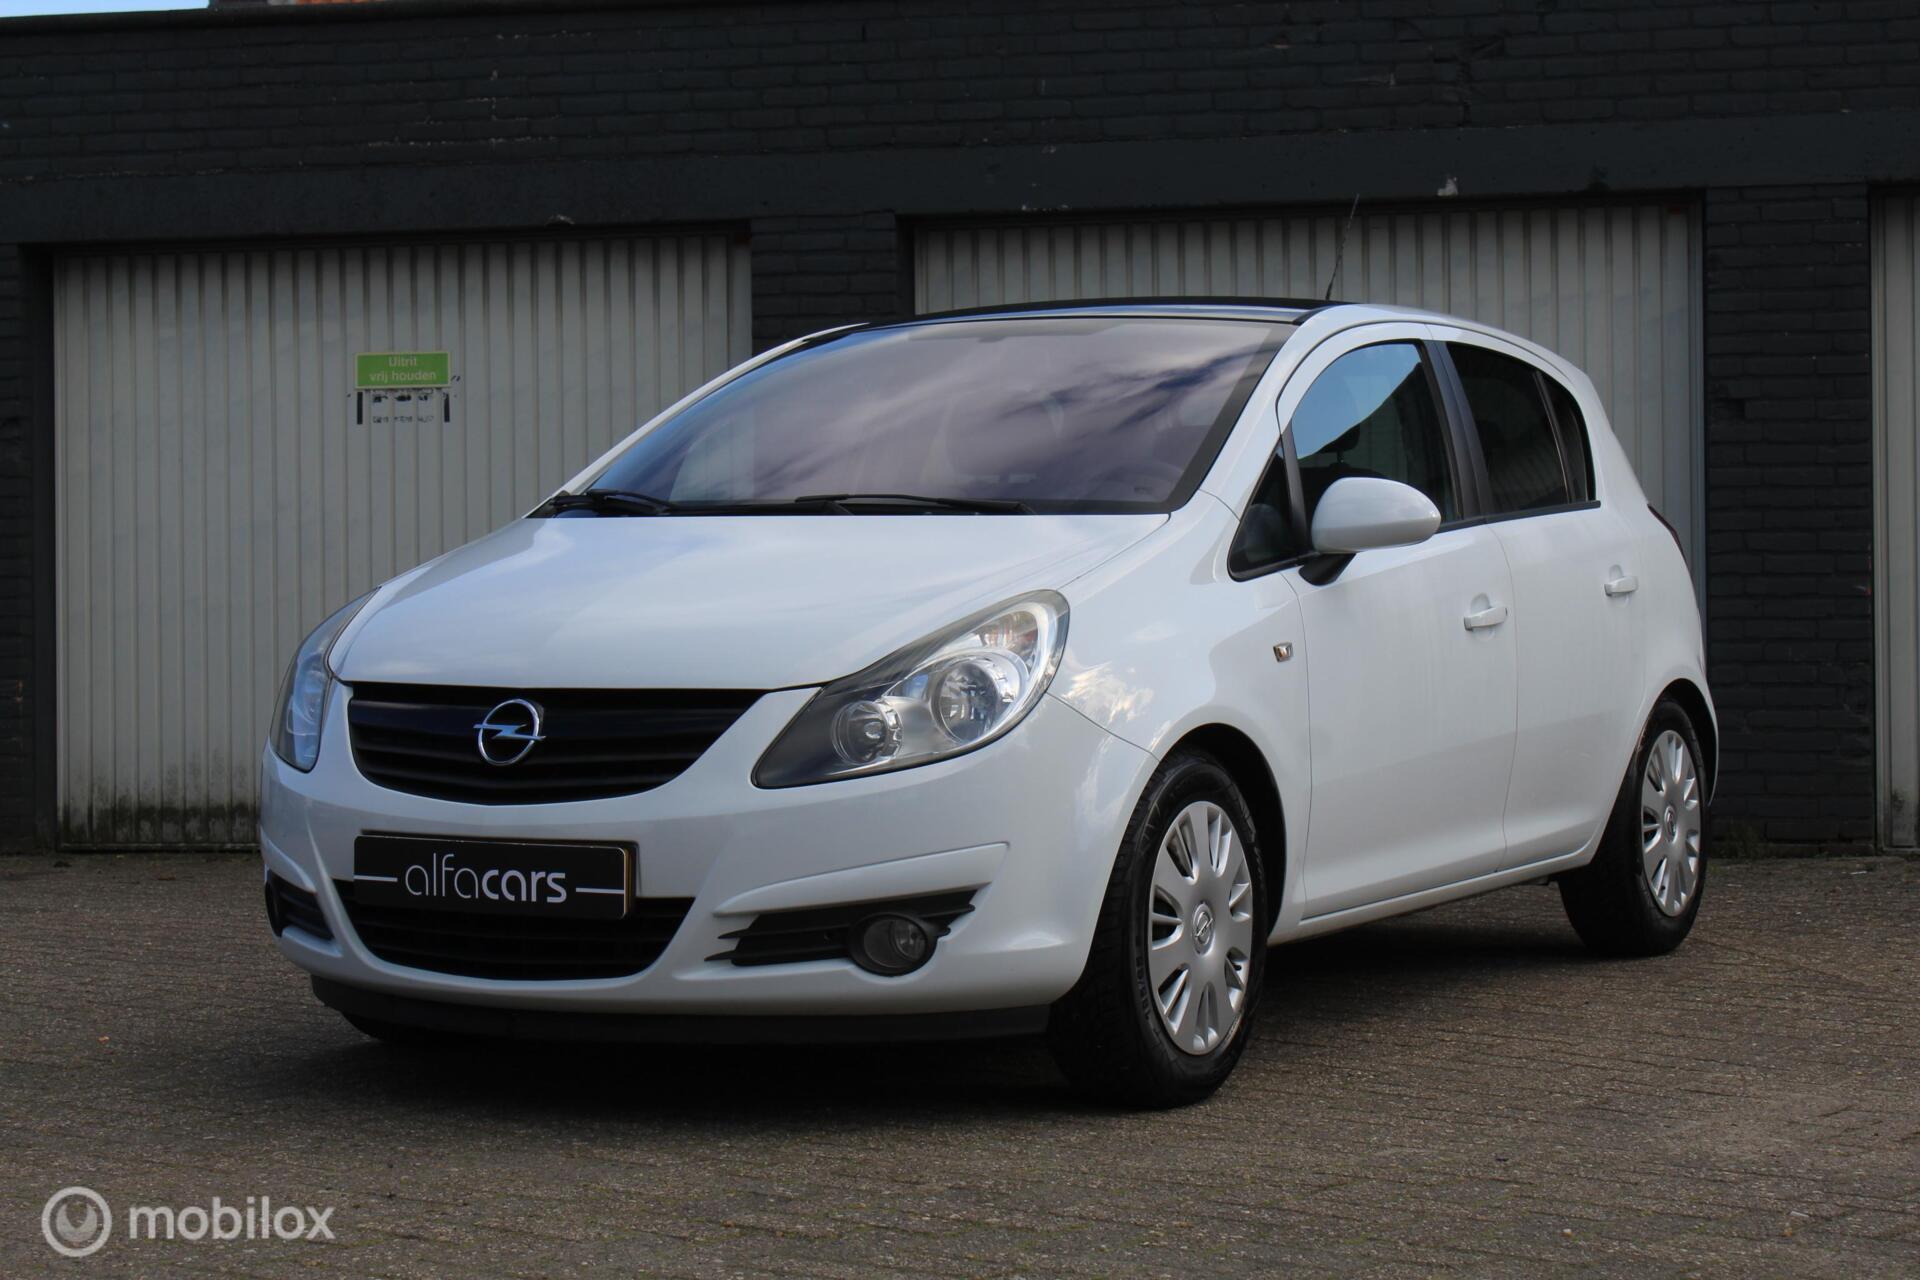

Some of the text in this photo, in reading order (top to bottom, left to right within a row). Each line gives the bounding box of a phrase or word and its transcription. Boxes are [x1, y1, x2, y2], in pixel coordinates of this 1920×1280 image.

[388, 355, 417, 367] Uitrit
[369, 369, 437, 383] vrij houden
[405, 852, 567, 903] alfacars
